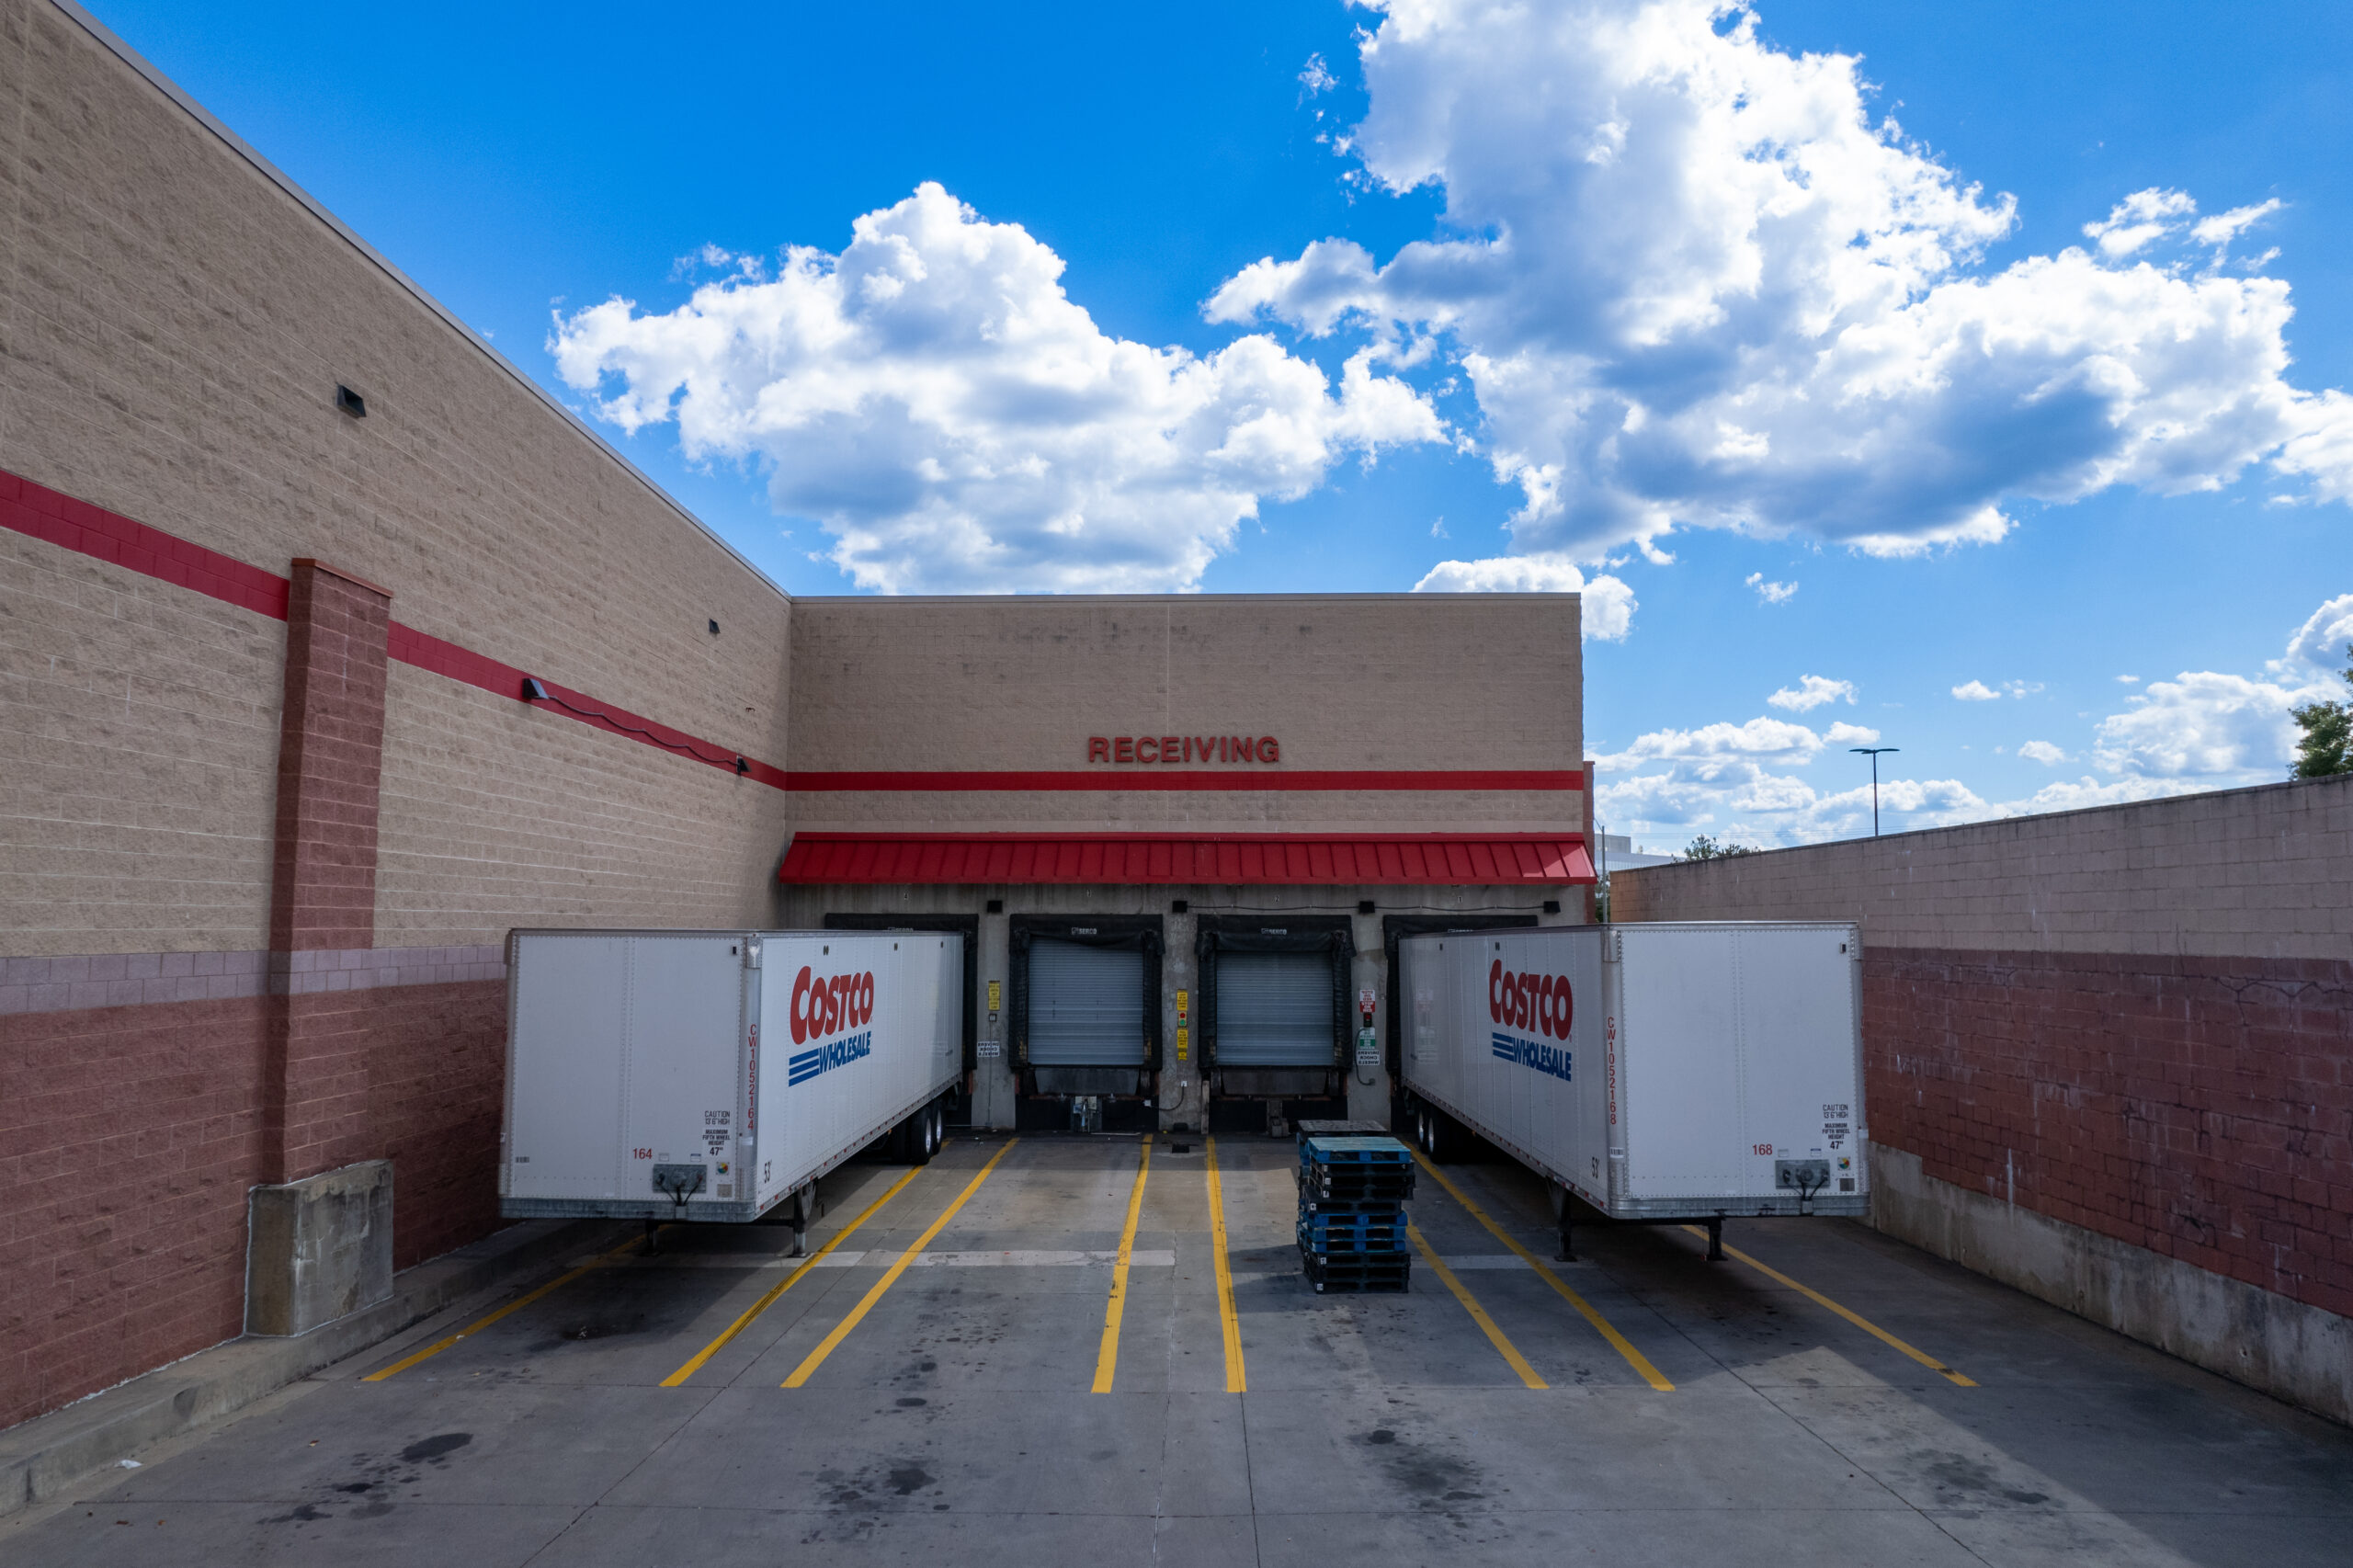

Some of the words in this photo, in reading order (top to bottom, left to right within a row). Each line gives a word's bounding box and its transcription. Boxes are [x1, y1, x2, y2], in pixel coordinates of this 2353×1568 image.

[1088, 736, 1279, 763] RECEIVING
[790, 965, 874, 1045] COSTCO
[1489, 959, 1573, 1040] COSTCO
[820, 1030, 871, 1074] WHOLESALE
[1512, 1037, 1572, 1082] WHOLESALE
[1607, 1016, 1617, 1125] CW1052168
[747, 1024, 757, 1131] CW1052164
[632, 1148, 653, 1160] 164
[1752, 1143, 1773, 1155] 168
